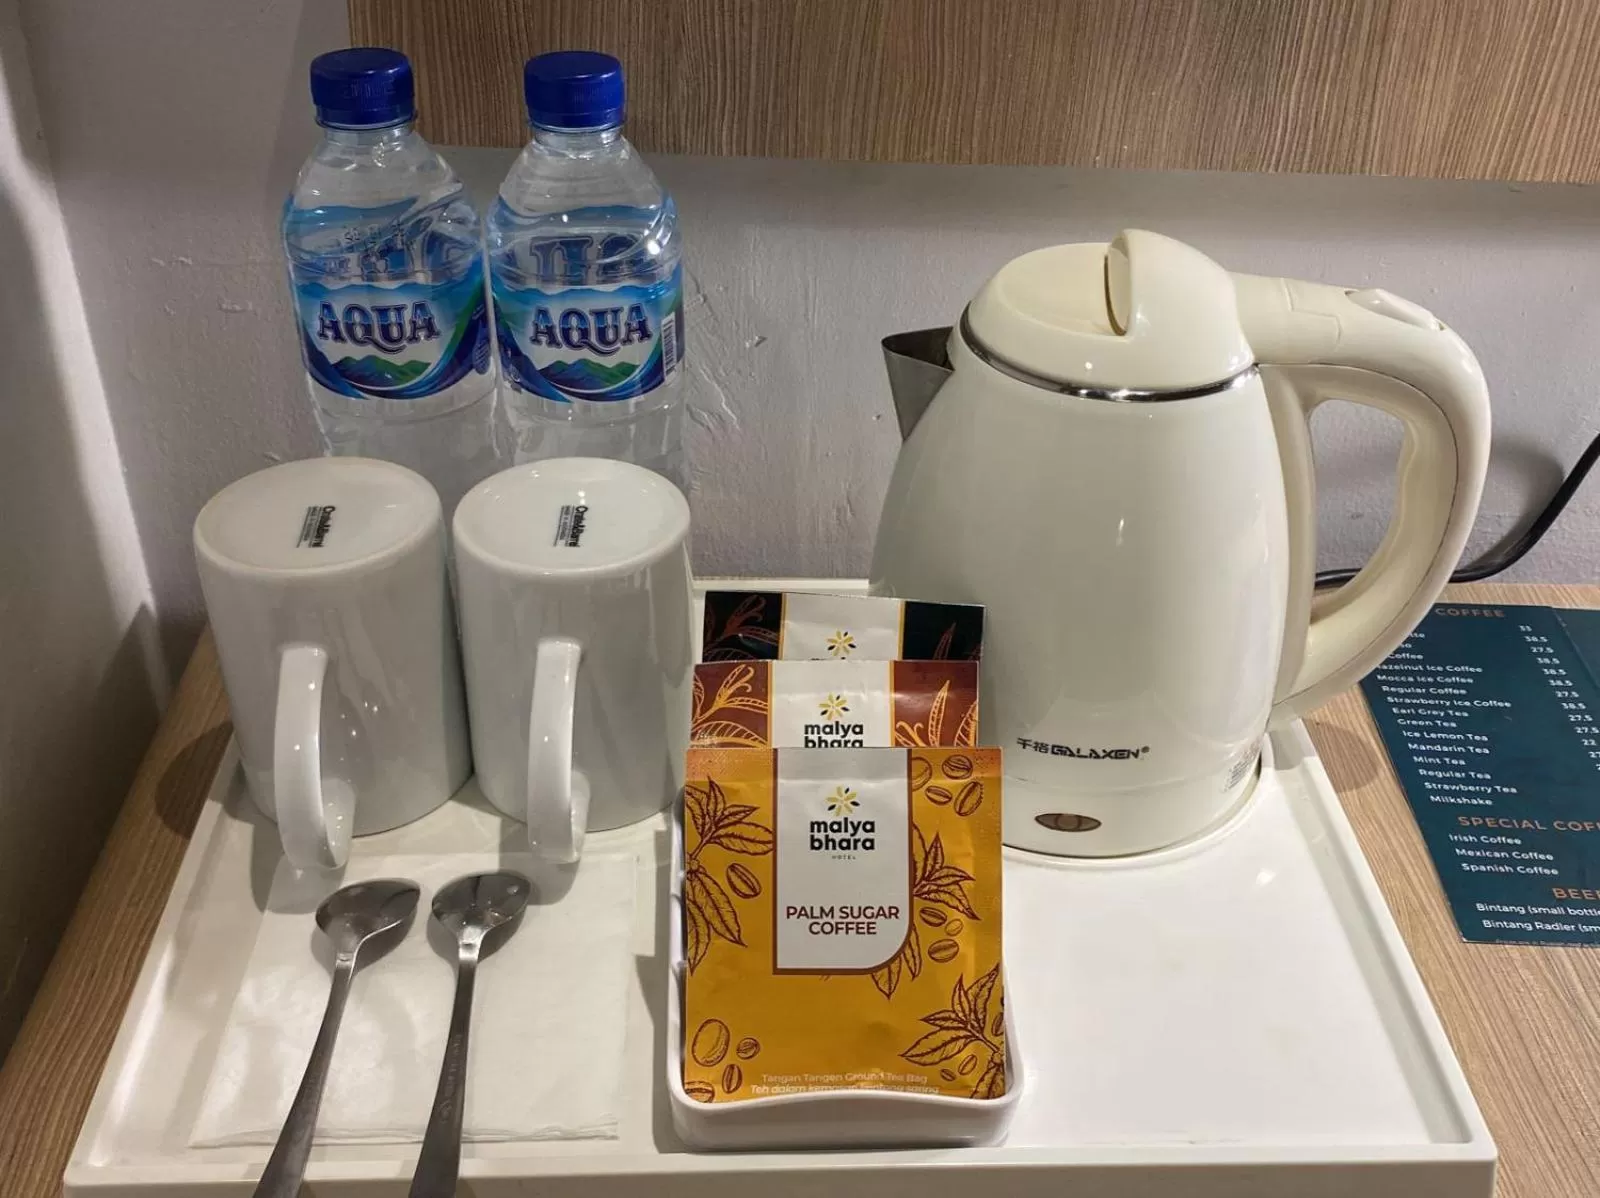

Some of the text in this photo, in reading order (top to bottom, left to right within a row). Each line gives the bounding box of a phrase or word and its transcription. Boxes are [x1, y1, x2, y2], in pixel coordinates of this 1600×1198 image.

[318, 300, 441, 354] AQUA
[530, 303, 653, 356] AQUA
[1434, 607, 1505, 618] COFFEE
[1426, 664, 1443, 672] Ice
[1446, 665, 1483, 673] Coffee
[1377, 674, 1474, 684] Mocca Ice Coffee
[1381, 685, 1468, 695] Regular Coffee
[1386, 696, 1512, 708] Strawberry Ice Coffee
[1392, 707, 1416, 715] Earl
[1447, 709, 1469, 717] Tea
[1568, 714, 1593, 722] 27.5
[804, 720, 864, 738] malya
[1397, 718, 1457, 728] Green Tea
[1402, 730, 1489, 742] Ice Lemon Tea
[1574, 726, 1600, 734] 27.5
[804, 736, 864, 748] bhara
[1407, 742, 1490, 754] Mandarin Tea
[1581, 738, 1597, 746] 22
[1413, 755, 1466, 766] Mint Tea
[1418, 768, 1492, 780] Regular Tea
[1424, 781, 1518, 794] Strawberry Tea
[1429, 795, 1493, 806] Milkshake
[810, 817, 875, 837] malya
[1457, 816, 1548, 830] SPECIAL
[810, 834, 875, 850] bhara
[1449, 834, 1522, 845] Irish Coffee
[1455, 848, 1554, 861] Mexican Coffee
[1461, 863, 1559, 875] Spanish Coffee
[786, 905, 900, 919] PALM SUGAR
[1476, 903, 1526, 914] Bintang
[1527, 905, 1566, 915] (small
[808, 921, 877, 935] COFFEE
[1482, 919, 1533, 931] Bintang
[1534, 921, 1576, 932] Radler
